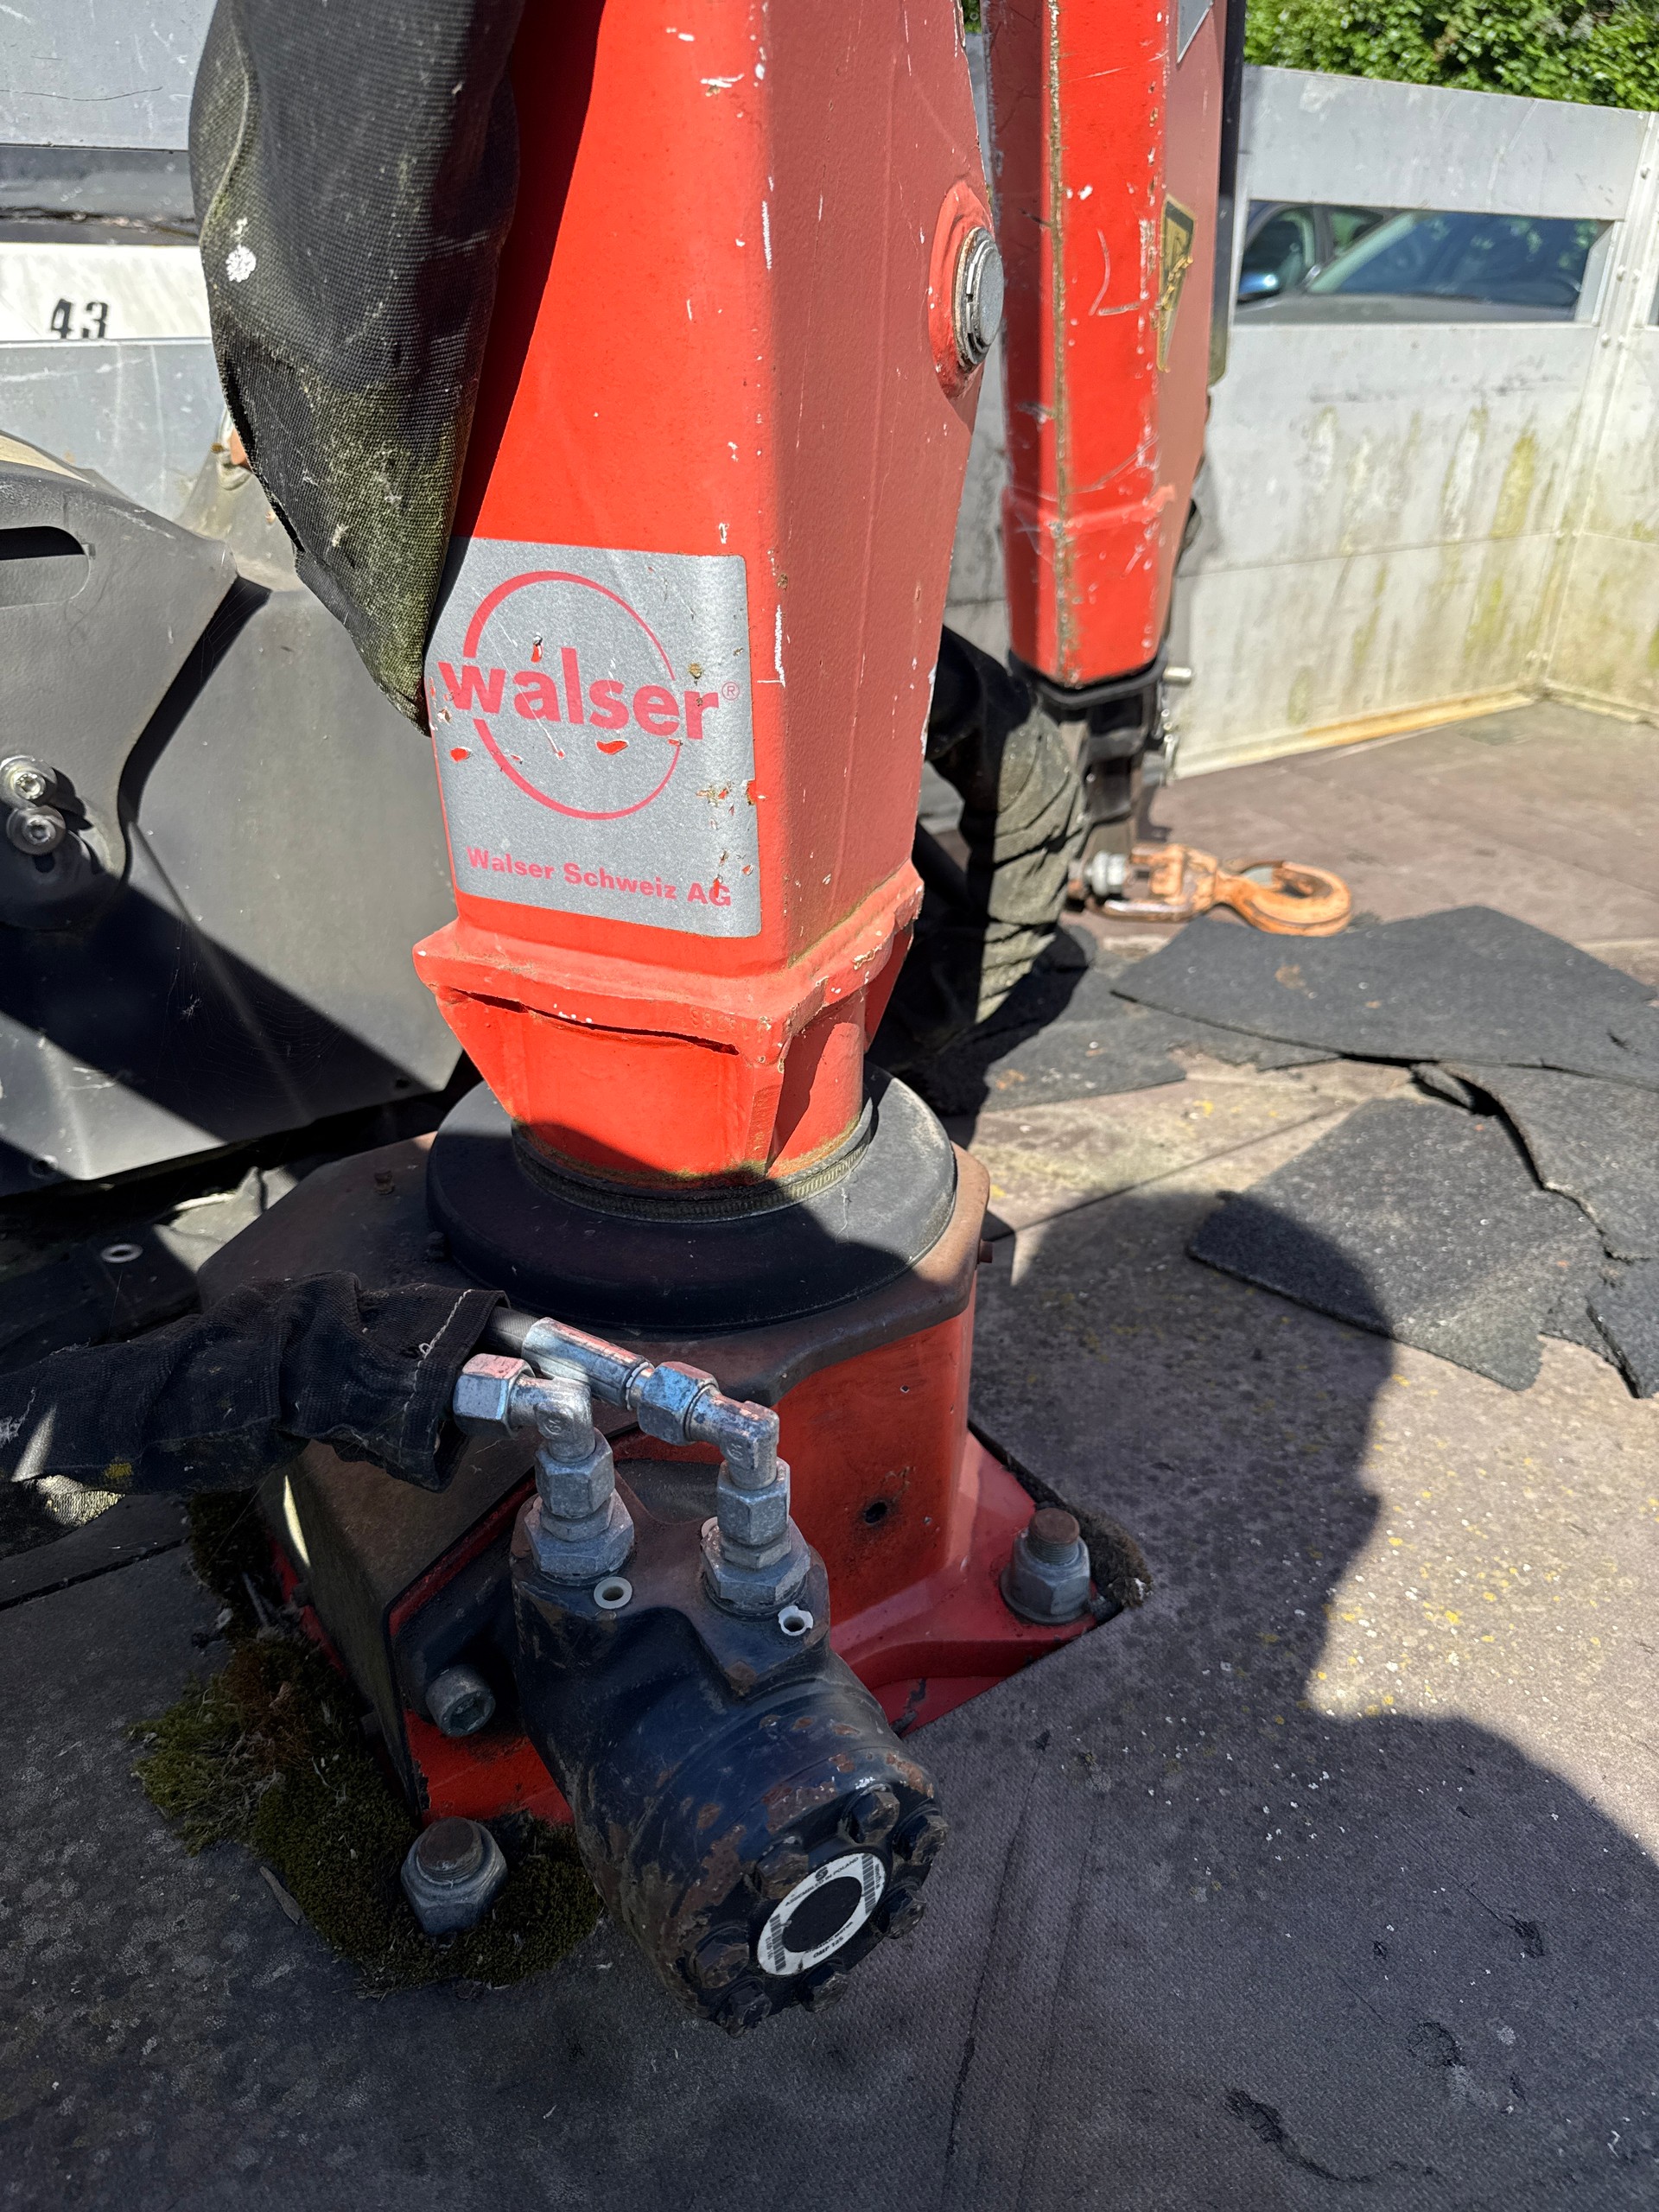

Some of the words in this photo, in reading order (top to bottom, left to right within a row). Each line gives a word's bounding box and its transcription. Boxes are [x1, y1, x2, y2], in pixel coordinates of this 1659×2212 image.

[51, 298, 108, 339] 43
[466, 846, 555, 880] Walser
[563, 861, 677, 900] Schweiz
[687, 878, 731, 906] AG
[785, 1879, 823, 1906] ASSEMBLED
[833, 1857, 859, 1876] POLAND
[813, 1945, 830, 1959] OMP
